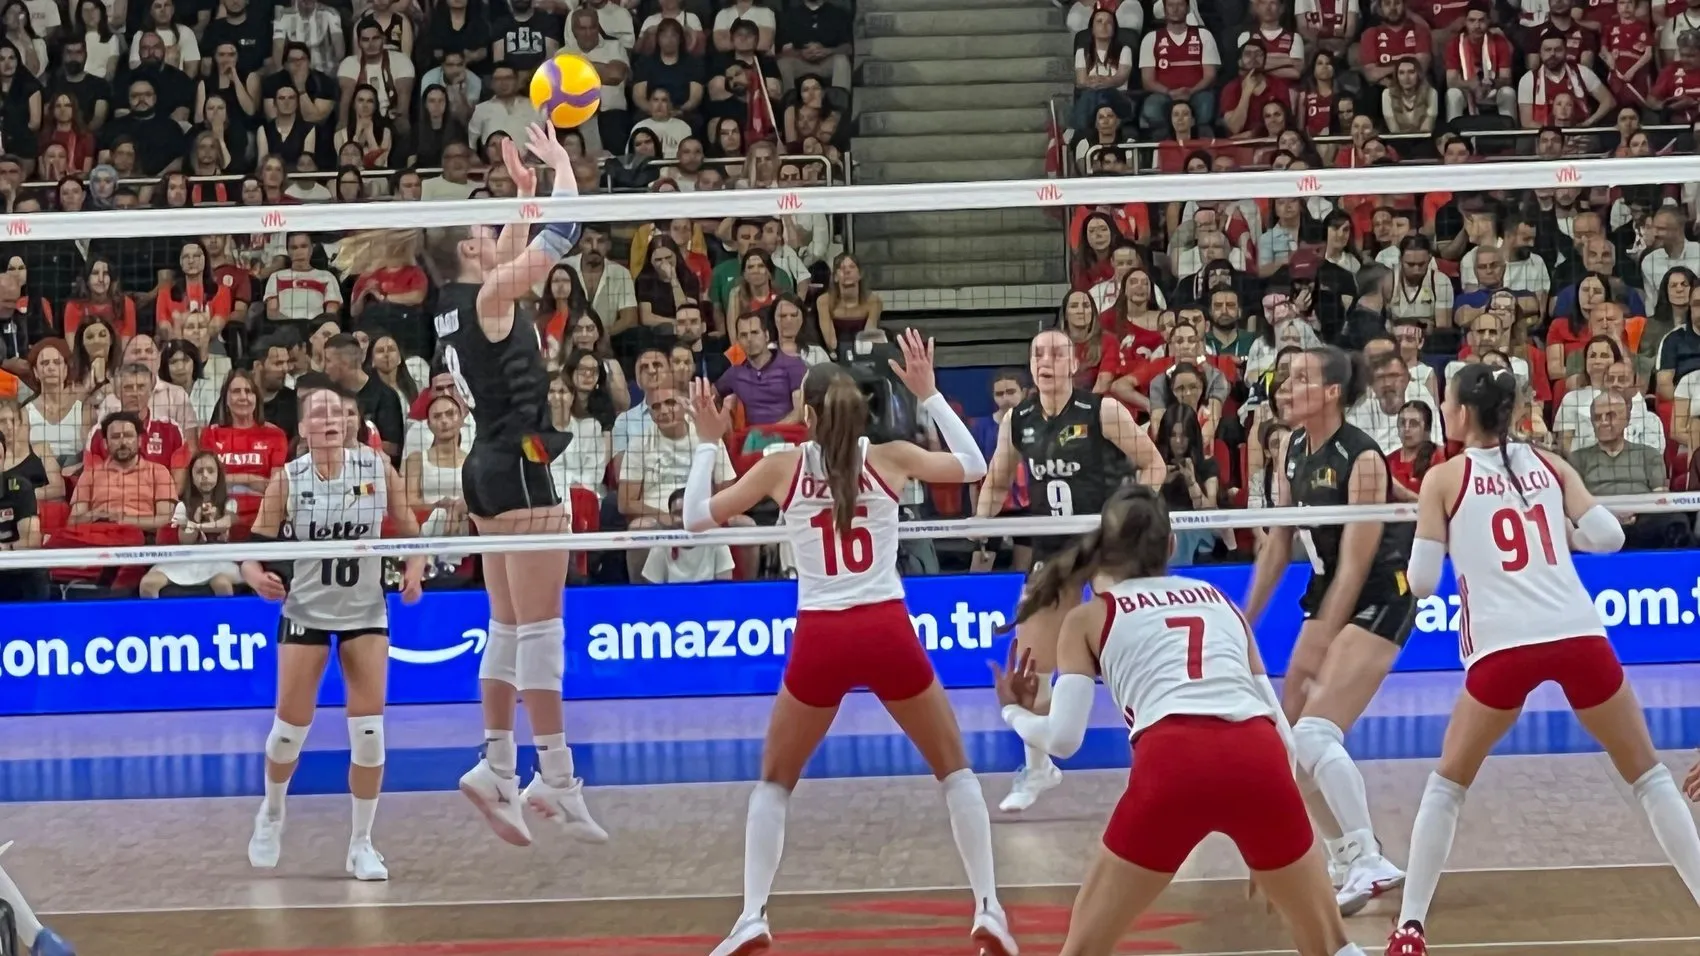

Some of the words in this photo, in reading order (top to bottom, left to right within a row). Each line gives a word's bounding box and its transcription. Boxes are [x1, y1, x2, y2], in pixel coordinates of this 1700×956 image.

[1556, 165, 1582, 182] VNL
[776, 192, 803, 209] VNL
[1036, 184, 1063, 200] VNL
[261, 210, 287, 227] VNL
[1029, 458, 1081, 481] lotto
[801, 472, 873, 499] ÖZN
[1474, 469, 1550, 500] BAŞLCU
[1047, 480, 1074, 517] 9
[309, 520, 370, 541] lotto
[810, 505, 874, 576] 16
[1491, 503, 1558, 572] 91
[1117, 586, 1221, 614] BALADIN
[0, 623, 267, 677] on.com.tr
[1165, 616, 1205, 680] 7
